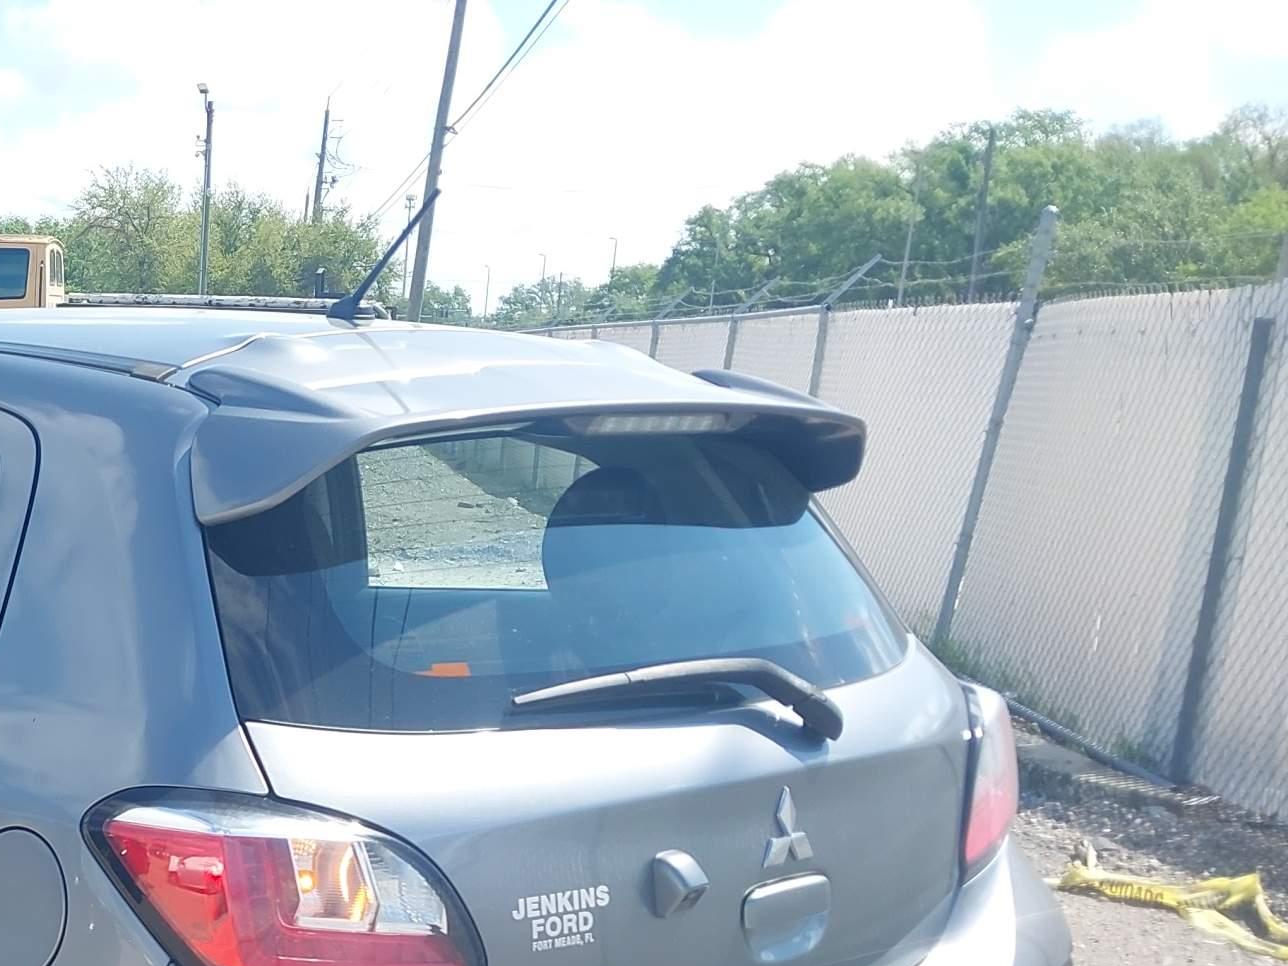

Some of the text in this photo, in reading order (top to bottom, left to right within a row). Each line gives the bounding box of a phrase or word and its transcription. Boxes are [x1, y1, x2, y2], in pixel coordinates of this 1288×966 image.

[511, 885, 611, 920] JENKINS
[532, 911, 594, 939] FORD
[532, 939, 553, 952] FORT
[584, 932, 595, 943] FL
